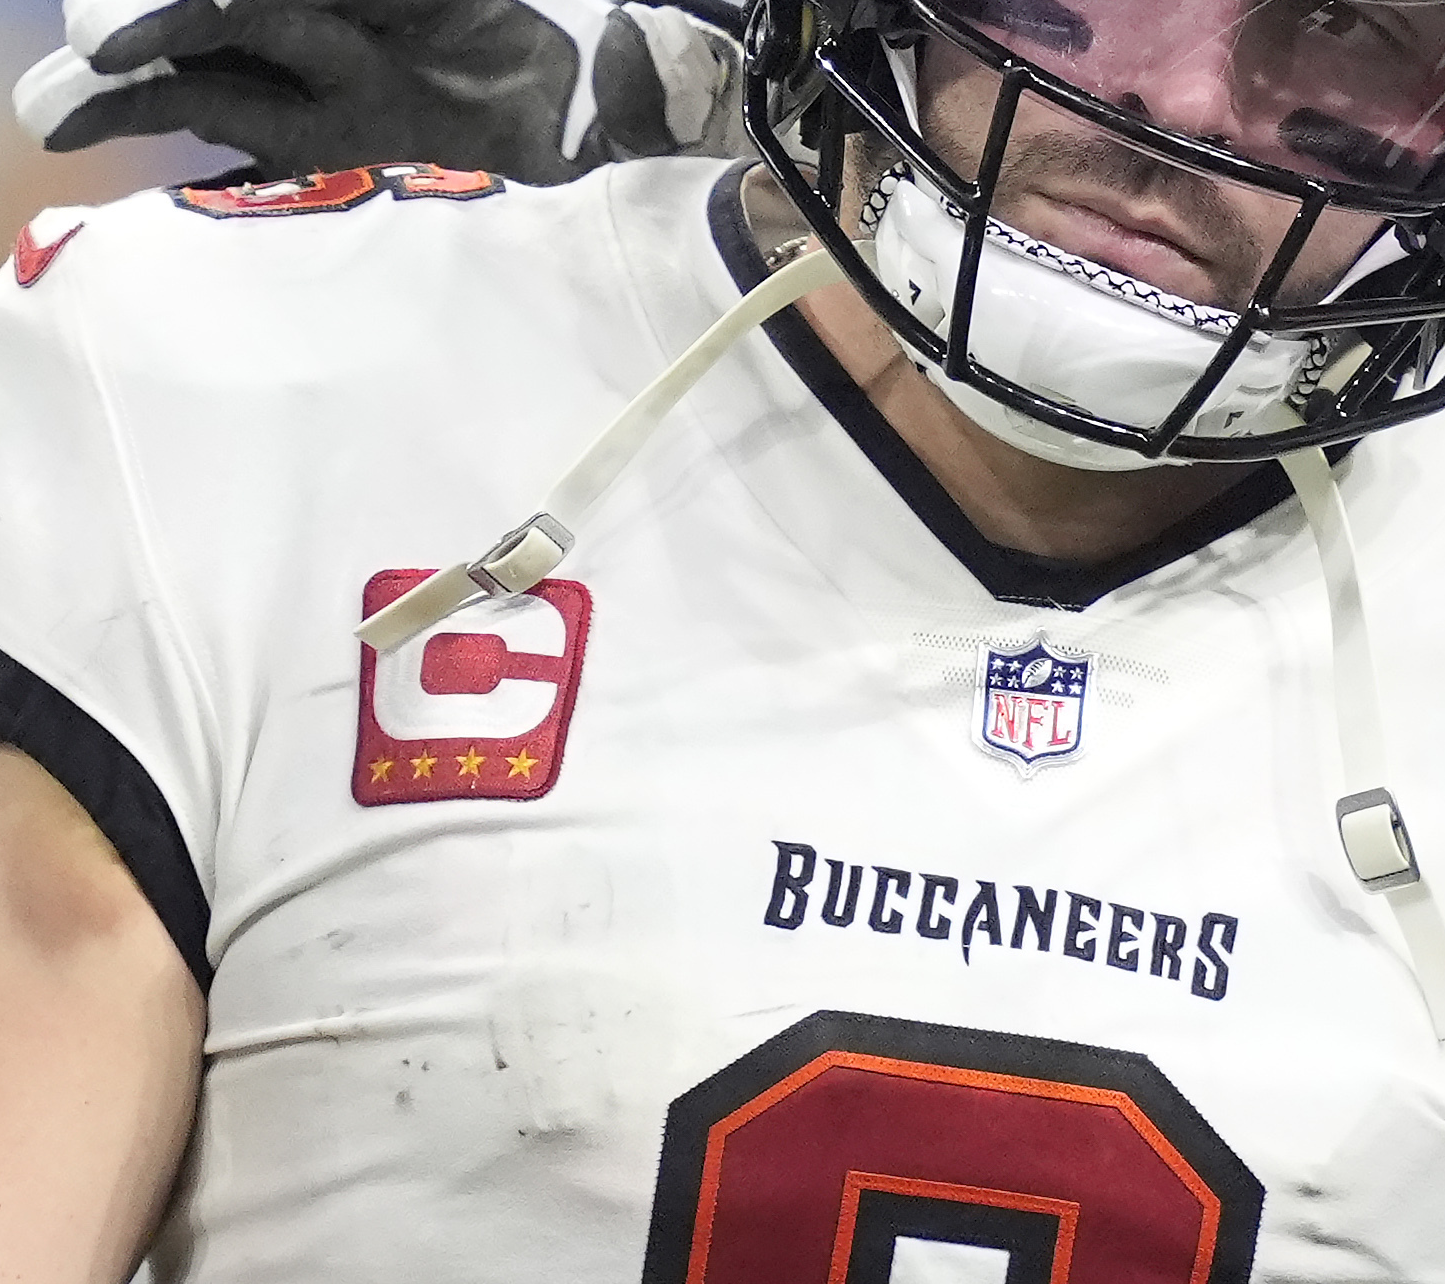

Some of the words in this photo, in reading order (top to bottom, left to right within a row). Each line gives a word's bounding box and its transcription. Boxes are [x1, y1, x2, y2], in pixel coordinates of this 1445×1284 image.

[373, 592, 568, 741] C
[992, 694, 1072, 751] NFL
[763, 840, 1239, 1002] BUCCANEERS
